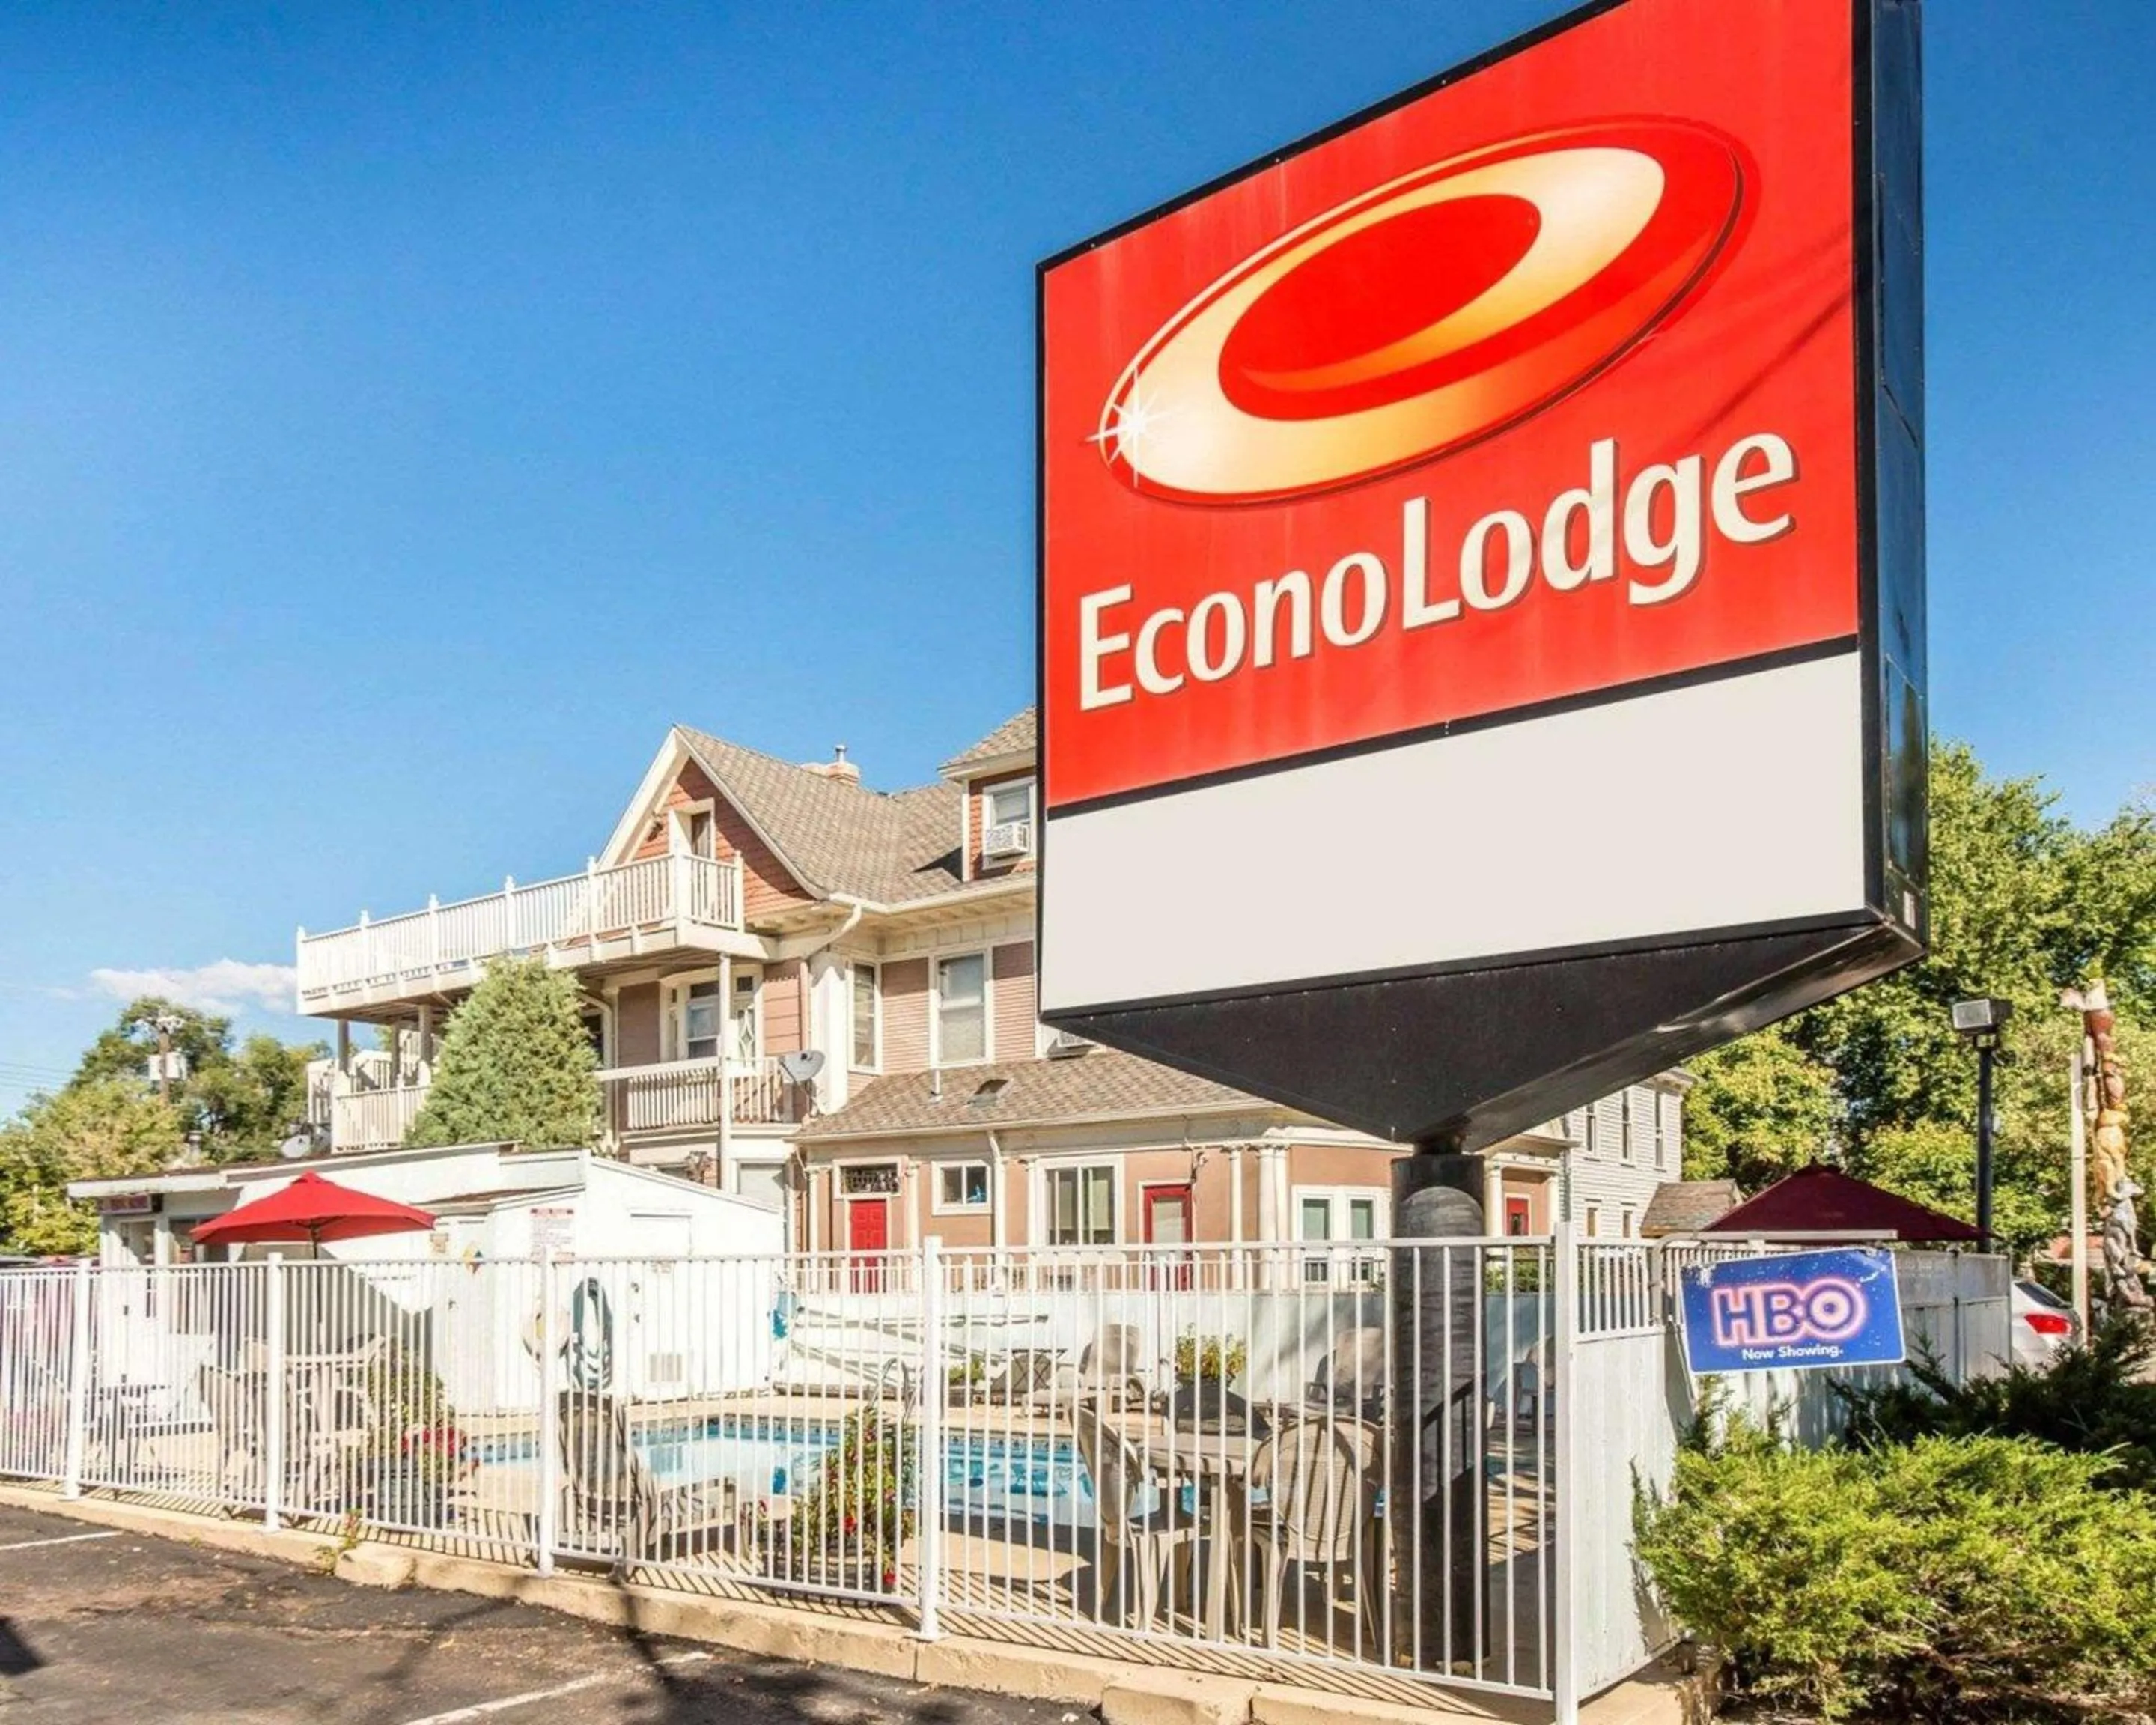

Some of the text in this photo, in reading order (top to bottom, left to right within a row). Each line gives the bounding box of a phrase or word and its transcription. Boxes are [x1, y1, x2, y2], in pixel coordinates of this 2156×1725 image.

[1079, 432, 1799, 713] EconoLodge
[1713, 1277, 1867, 1346] HBO
[1741, 1344, 1844, 1360] Now Showing.
